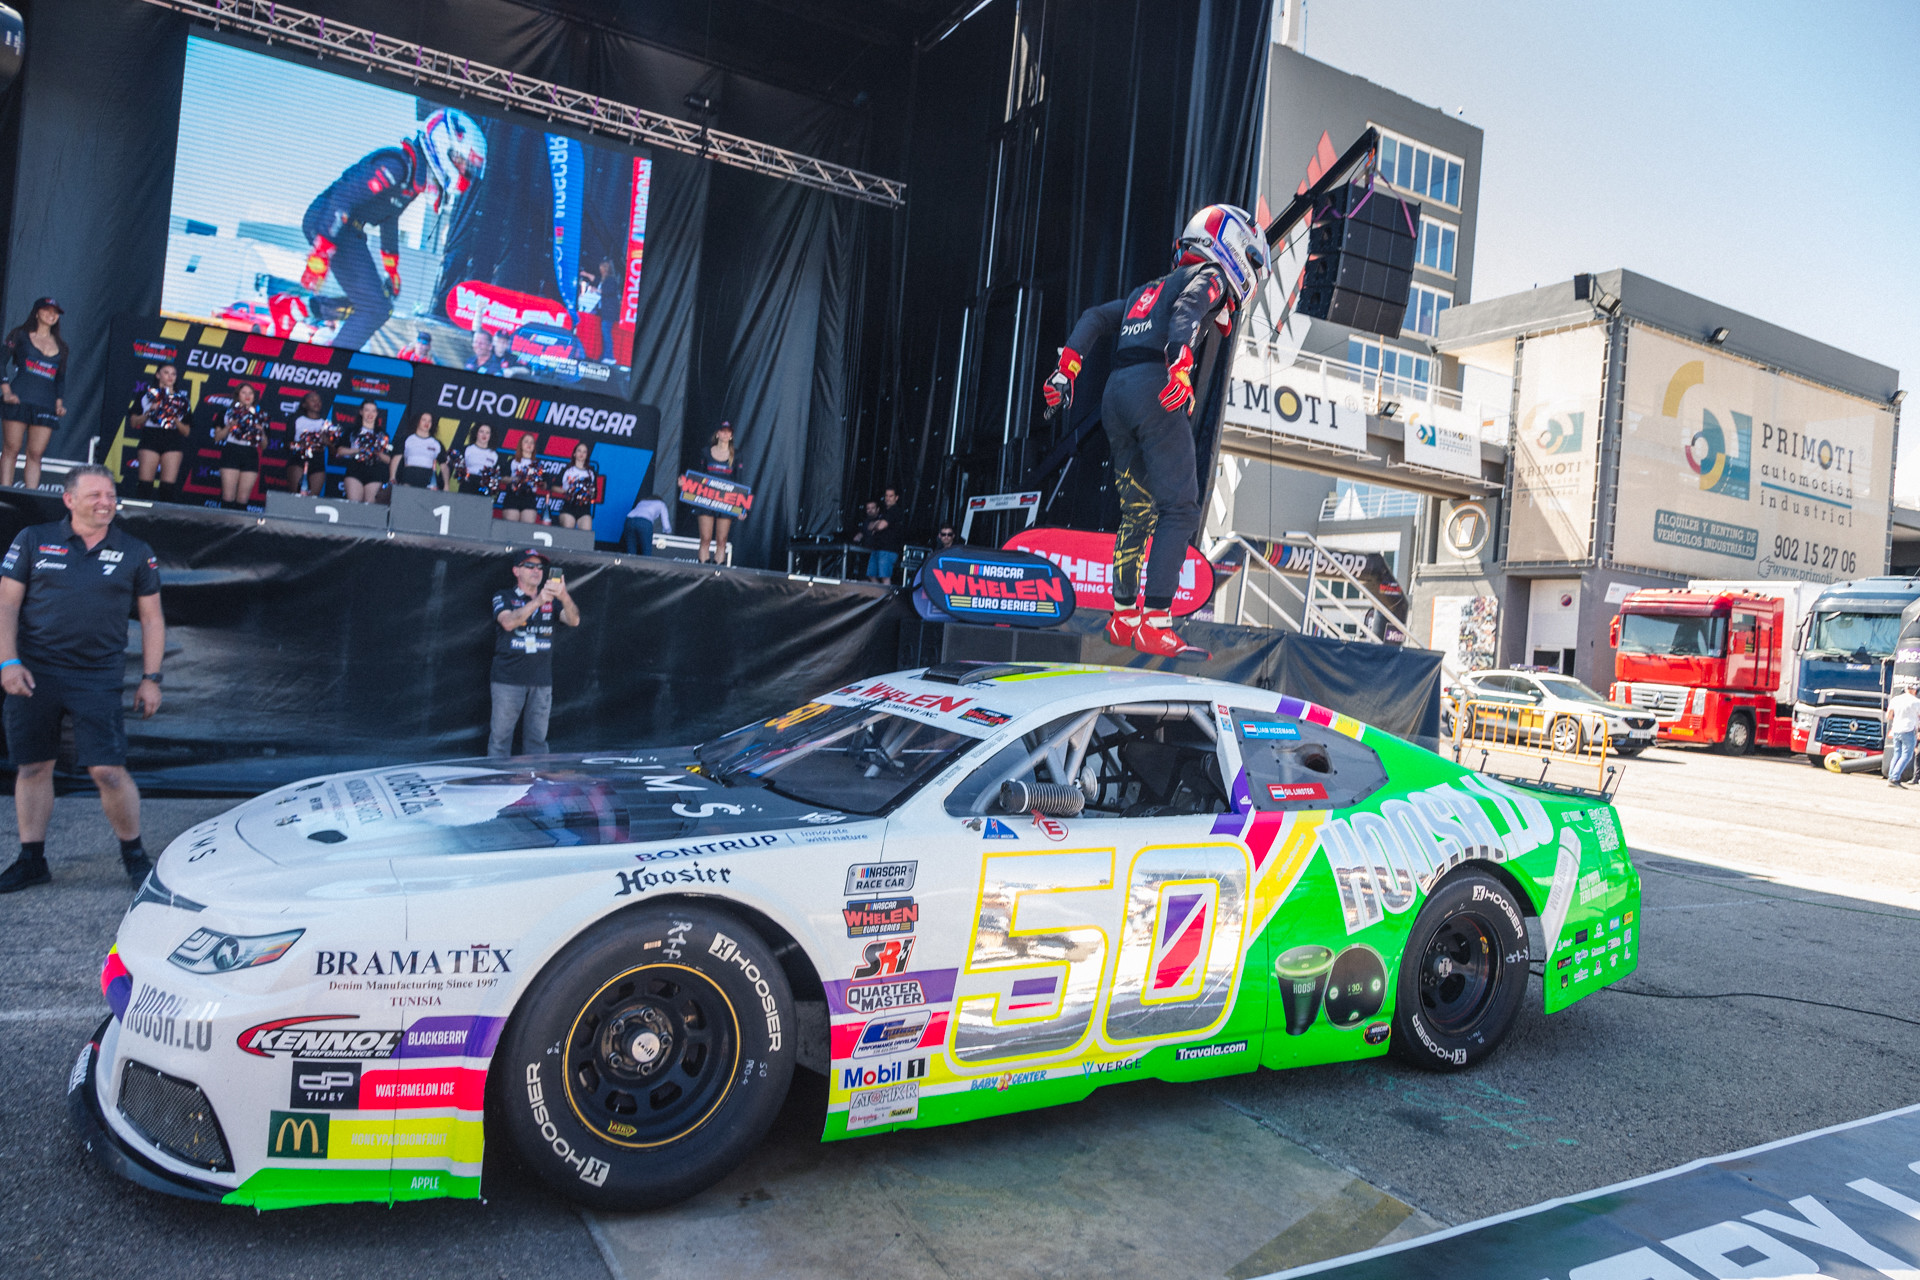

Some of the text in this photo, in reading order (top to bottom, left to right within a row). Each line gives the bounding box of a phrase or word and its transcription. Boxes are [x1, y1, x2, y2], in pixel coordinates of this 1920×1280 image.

[456, 286, 568, 328] WHELEN
[186, 349, 342, 389] EURO NASCAR
[438, 383, 637, 437] EURO NASCAR
[1761, 422, 1854, 475] PRIMOTI
[681, 474, 754, 510] WHELEN
[1761, 463, 1854, 499] automoción
[433, 505, 451, 535] 1
[1760, 490, 1853, 527] industrial
[1657, 513, 1757, 543] ALQUILER Y RENTING DE
[1656, 527, 1755, 558] VEHÍCULOS INDUSTRIALES
[1774, 534, 1856, 574] 902 15 27 06
[98, 549, 124, 563] 50
[102, 564, 117, 576] 7
[982, 564, 1024, 580] NASCAR
[932, 568, 1064, 603] WHELEN
[971, 597, 1036, 613] EURO SERIES
[860, 681, 977, 713] WHELEN
[635, 834, 778, 863] BONTRUP
[614, 861, 732, 897] Hoosier
[869, 865, 907, 878] NASCAR
[855, 878, 905, 890] RACE CAR
[843, 904, 918, 928] WHELEN
[872, 901, 897, 911] NASCAR
[1484, 891, 1524, 940] HOOSIER
[862, 922, 901, 935] EURO SERIES
[314, 947, 514, 977] BRAMATEX
[948, 842, 1251, 1068] 50
[328, 977, 499, 992] Denim Manufacturing Since 1997
[848, 982, 918, 1005] QUARTER
[1293, 981, 1316, 994] HOOSH
[389, 995, 443, 1008] TUNISIA
[730, 949, 783, 1053] HOOSIER
[861, 992, 922, 1012] MASTER
[247, 1030, 399, 1052] KENNOL
[408, 1030, 468, 1046] BLACKBERRY
[1411, 1013, 1455, 1062] HOOSIER
[298, 1049, 391, 1059] PERFORMANCE OIL
[1177, 1043, 1246, 1060] Travala.com
[843, 1059, 920, 1089] Mobil 1
[1097, 1058, 1142, 1074] VERGE
[375, 1082, 455, 1098] WATERMELON ICE
[970, 1070, 1047, 1092] BABY CENTER
[306, 1092, 344, 1102] TIJEY
[525, 1061, 588, 1172] HOOSIER
[351, 1132, 448, 1147] HONEYPASSIONFRUIT
[410, 1176, 440, 1190] APPLE
